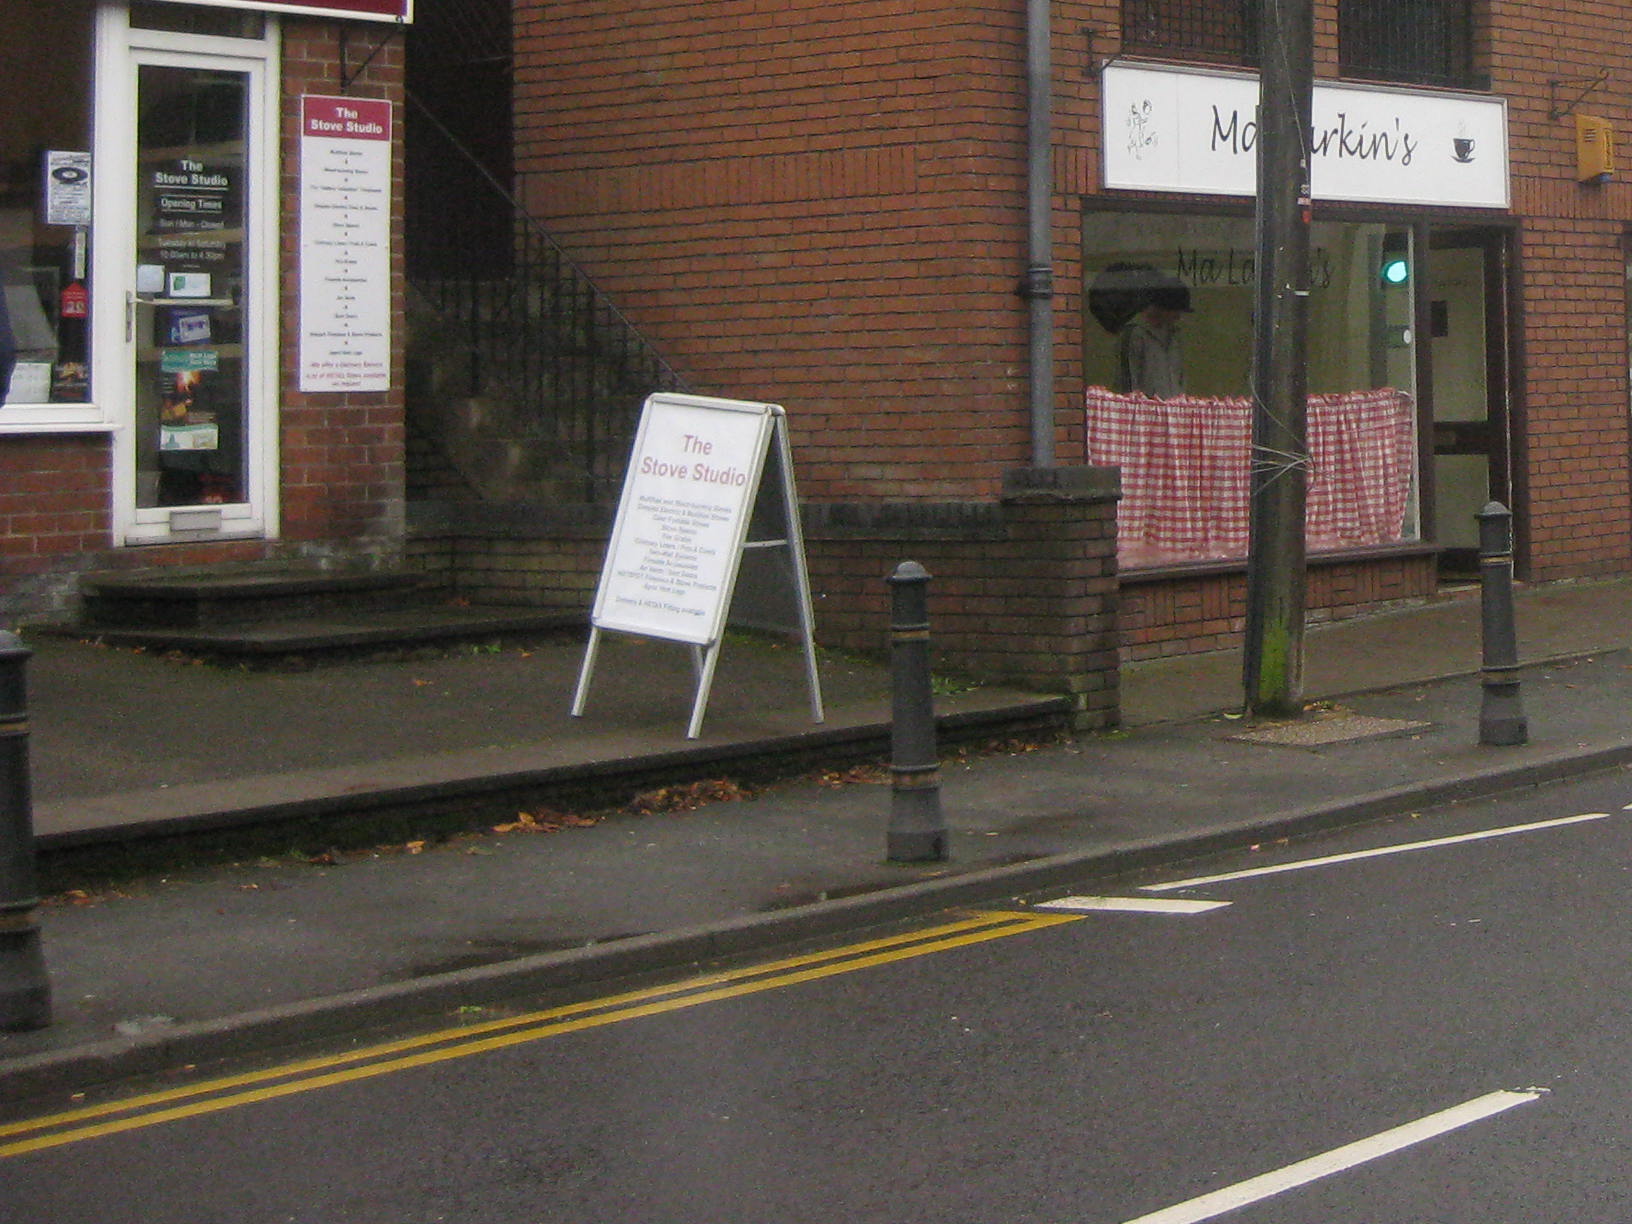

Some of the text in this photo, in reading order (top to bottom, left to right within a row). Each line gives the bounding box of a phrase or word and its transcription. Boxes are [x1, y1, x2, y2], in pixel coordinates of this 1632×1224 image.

[336, 107, 358, 119] The
[311, 119, 383, 134] Stove Studio
[1311, 113, 1419, 166] rkin's
[181, 160, 204, 172] The
[155, 172, 228, 186] Stove Studio
[161, 198, 196, 210] Opening
[683, 435, 713, 456] The
[641, 456, 746, 487] Stove Studio
